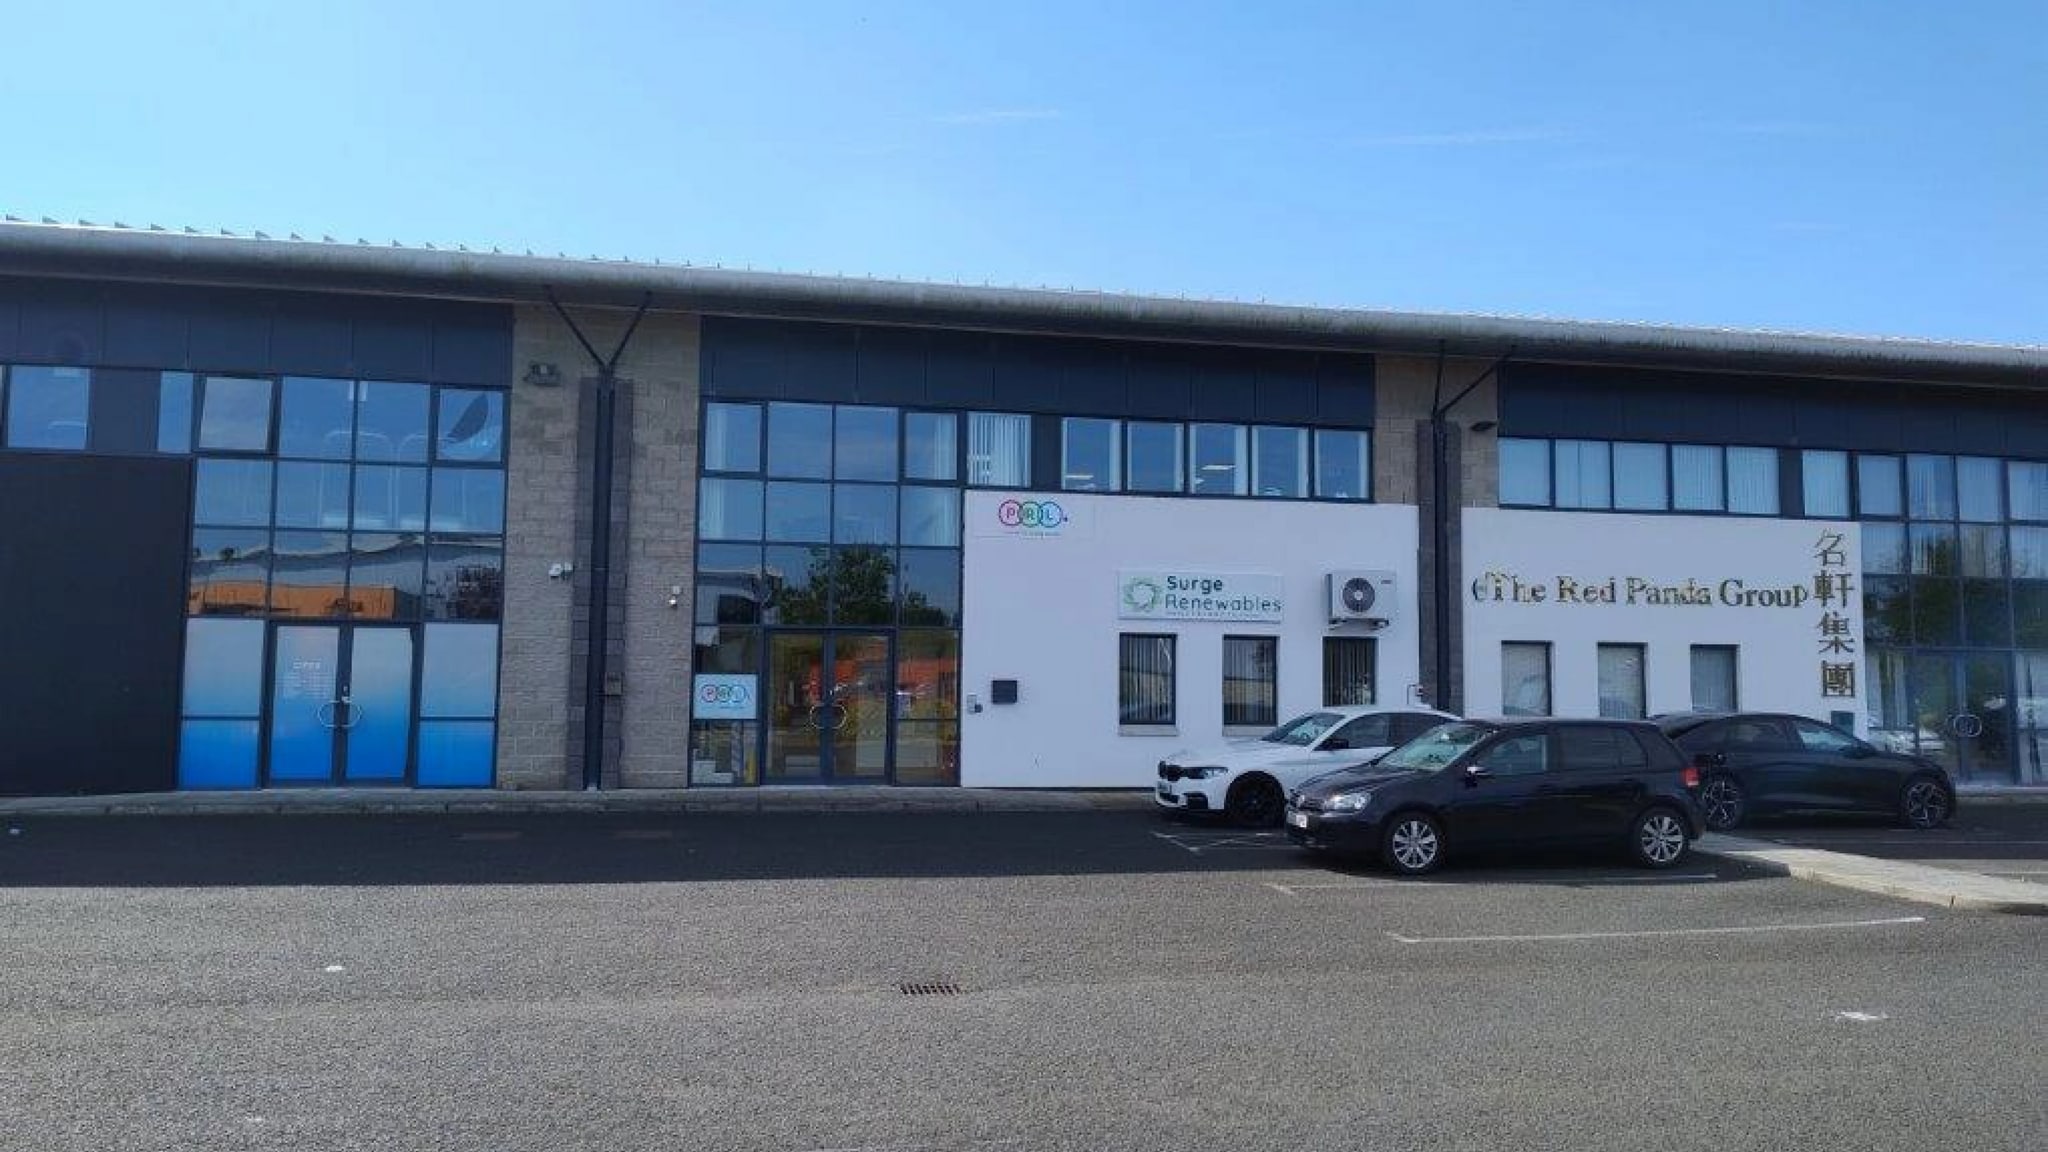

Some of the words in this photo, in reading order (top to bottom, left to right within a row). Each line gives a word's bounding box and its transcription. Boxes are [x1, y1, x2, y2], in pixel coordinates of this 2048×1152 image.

[1167, 575, 1223, 594] Surge
[1472, 571, 1547, 603] The
[1555, 575, 1616, 603] Red
[1625, 577, 1711, 605] Panda
[1719, 578, 1807, 608] Group
[1165, 594, 1281, 611] Renewables
[1814, 528, 1855, 697] 名軒集團
